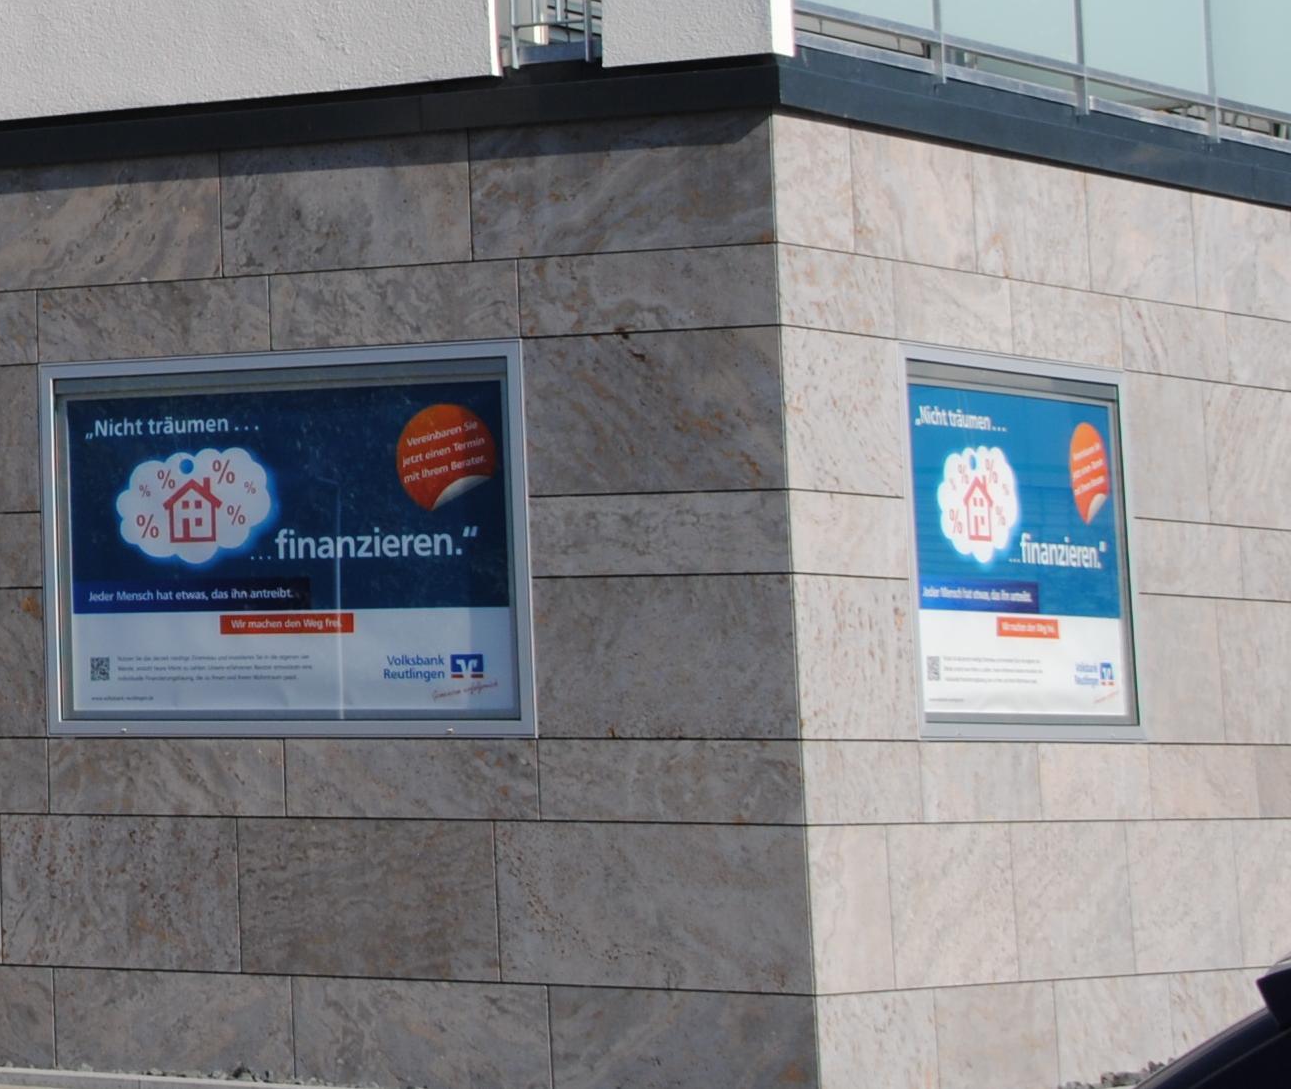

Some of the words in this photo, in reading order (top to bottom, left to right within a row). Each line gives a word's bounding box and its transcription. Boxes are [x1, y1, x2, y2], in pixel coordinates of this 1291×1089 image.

[406, 425, 462, 447] Vereinbaren
[402, 453, 423, 468] jetzt
[425, 446, 451, 459] einen
[452, 435, 485, 451] Termin
[404, 472, 420, 484] mit
[421, 465, 449, 478] Ihrem
[88, 590, 114, 602] Jeder
[116, 590, 153, 601] Mensch
[156, 590, 172, 601] hat
[175, 591, 208, 601] etwas,
[211, 589, 228, 599] das
[231, 588, 247, 598] ihn
[250, 587, 294, 598] antreibt.
[231, 619, 246, 628] Wir
[248, 618, 283, 628] machen
[284, 618, 301, 628] den
[303, 618, 323, 631] Weg
[386, 655, 445, 666] Volksbank
[383, 668, 445, 682] Reutlingen
